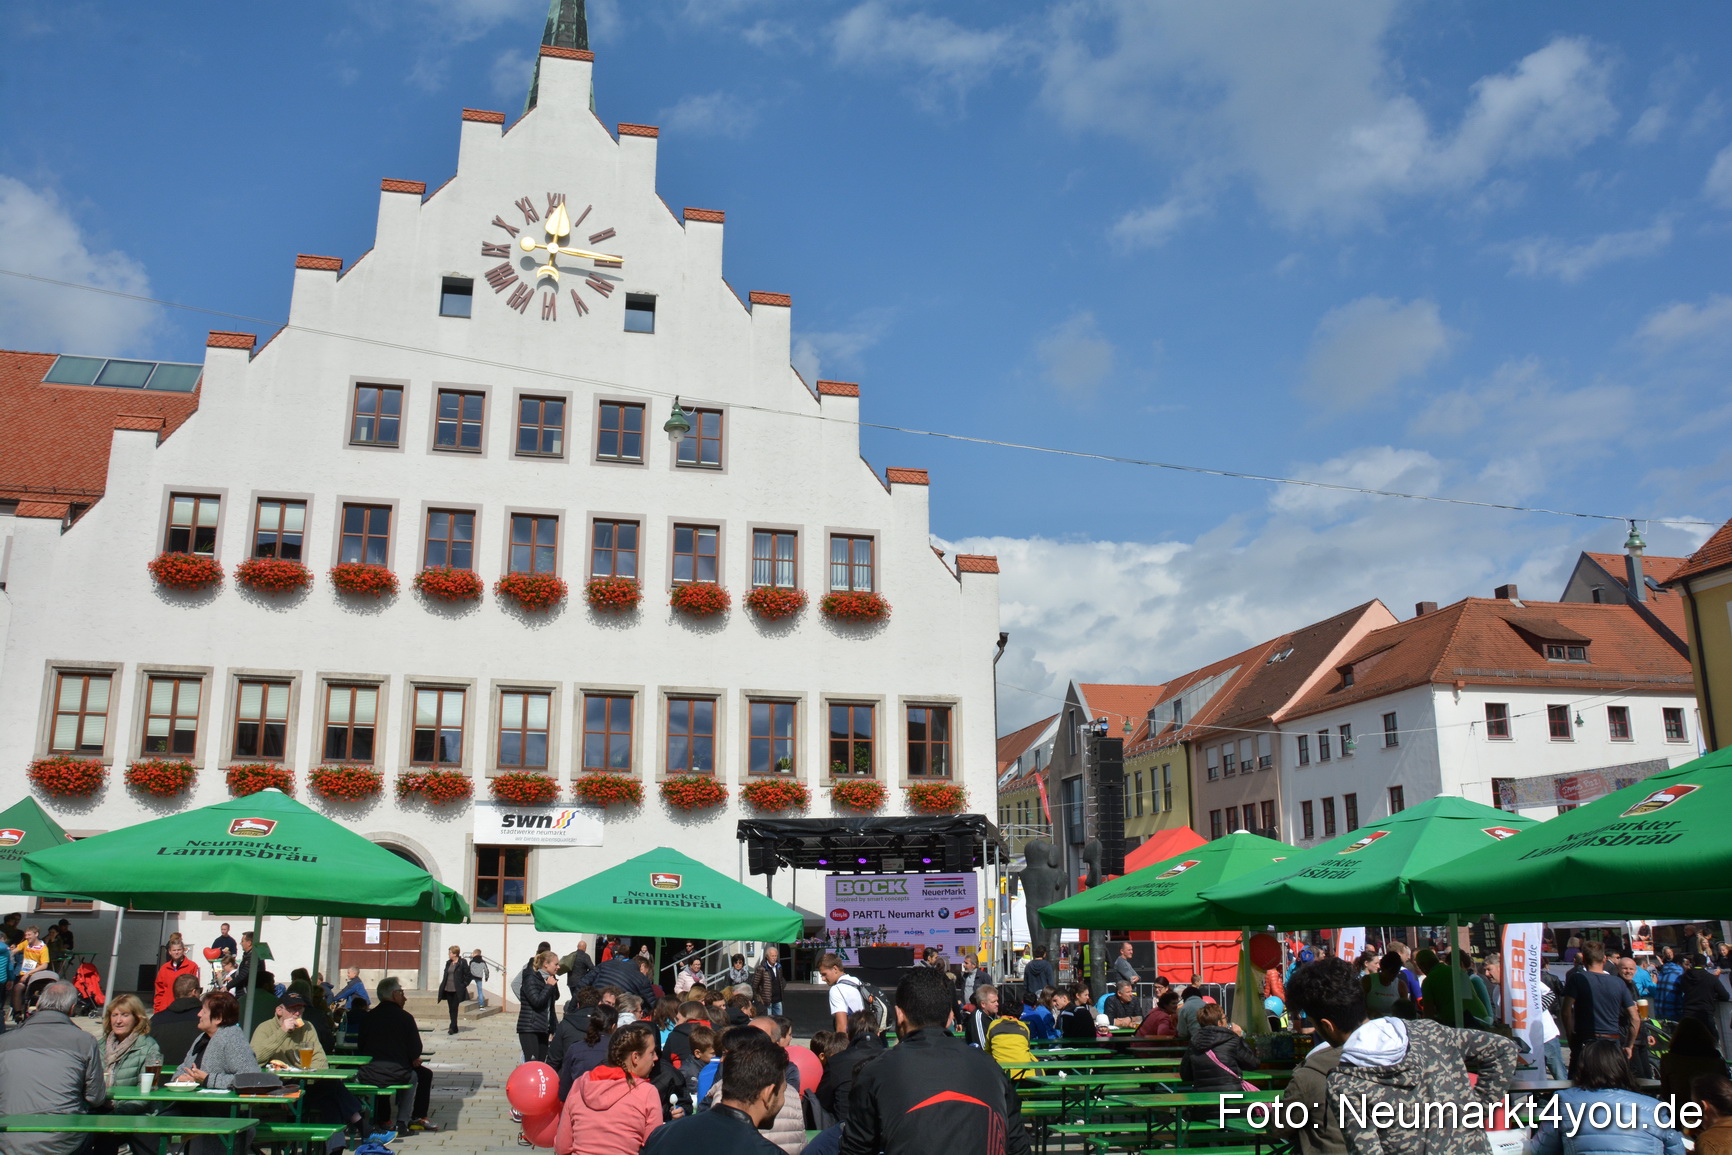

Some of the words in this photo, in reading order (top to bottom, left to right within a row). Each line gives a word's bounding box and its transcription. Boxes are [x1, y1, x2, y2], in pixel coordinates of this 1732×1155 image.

[501, 814, 553, 829] swn
[186, 840, 302, 852] Neumarkter
[156, 847, 318, 863] Lammsbräu
[836, 878, 908, 896] BOCK
[922, 888, 966, 896] NeuerMarkt
[612, 895, 722, 909] Lammsbräu
[628, 890, 707, 901] Neumarkter
[852, 911, 885, 919] PARTL
[887, 909, 935, 919] Neumarkt
[1511, 932, 1528, 1029] KLEBL
[1528, 944, 1539, 1010] www.klebl.de
